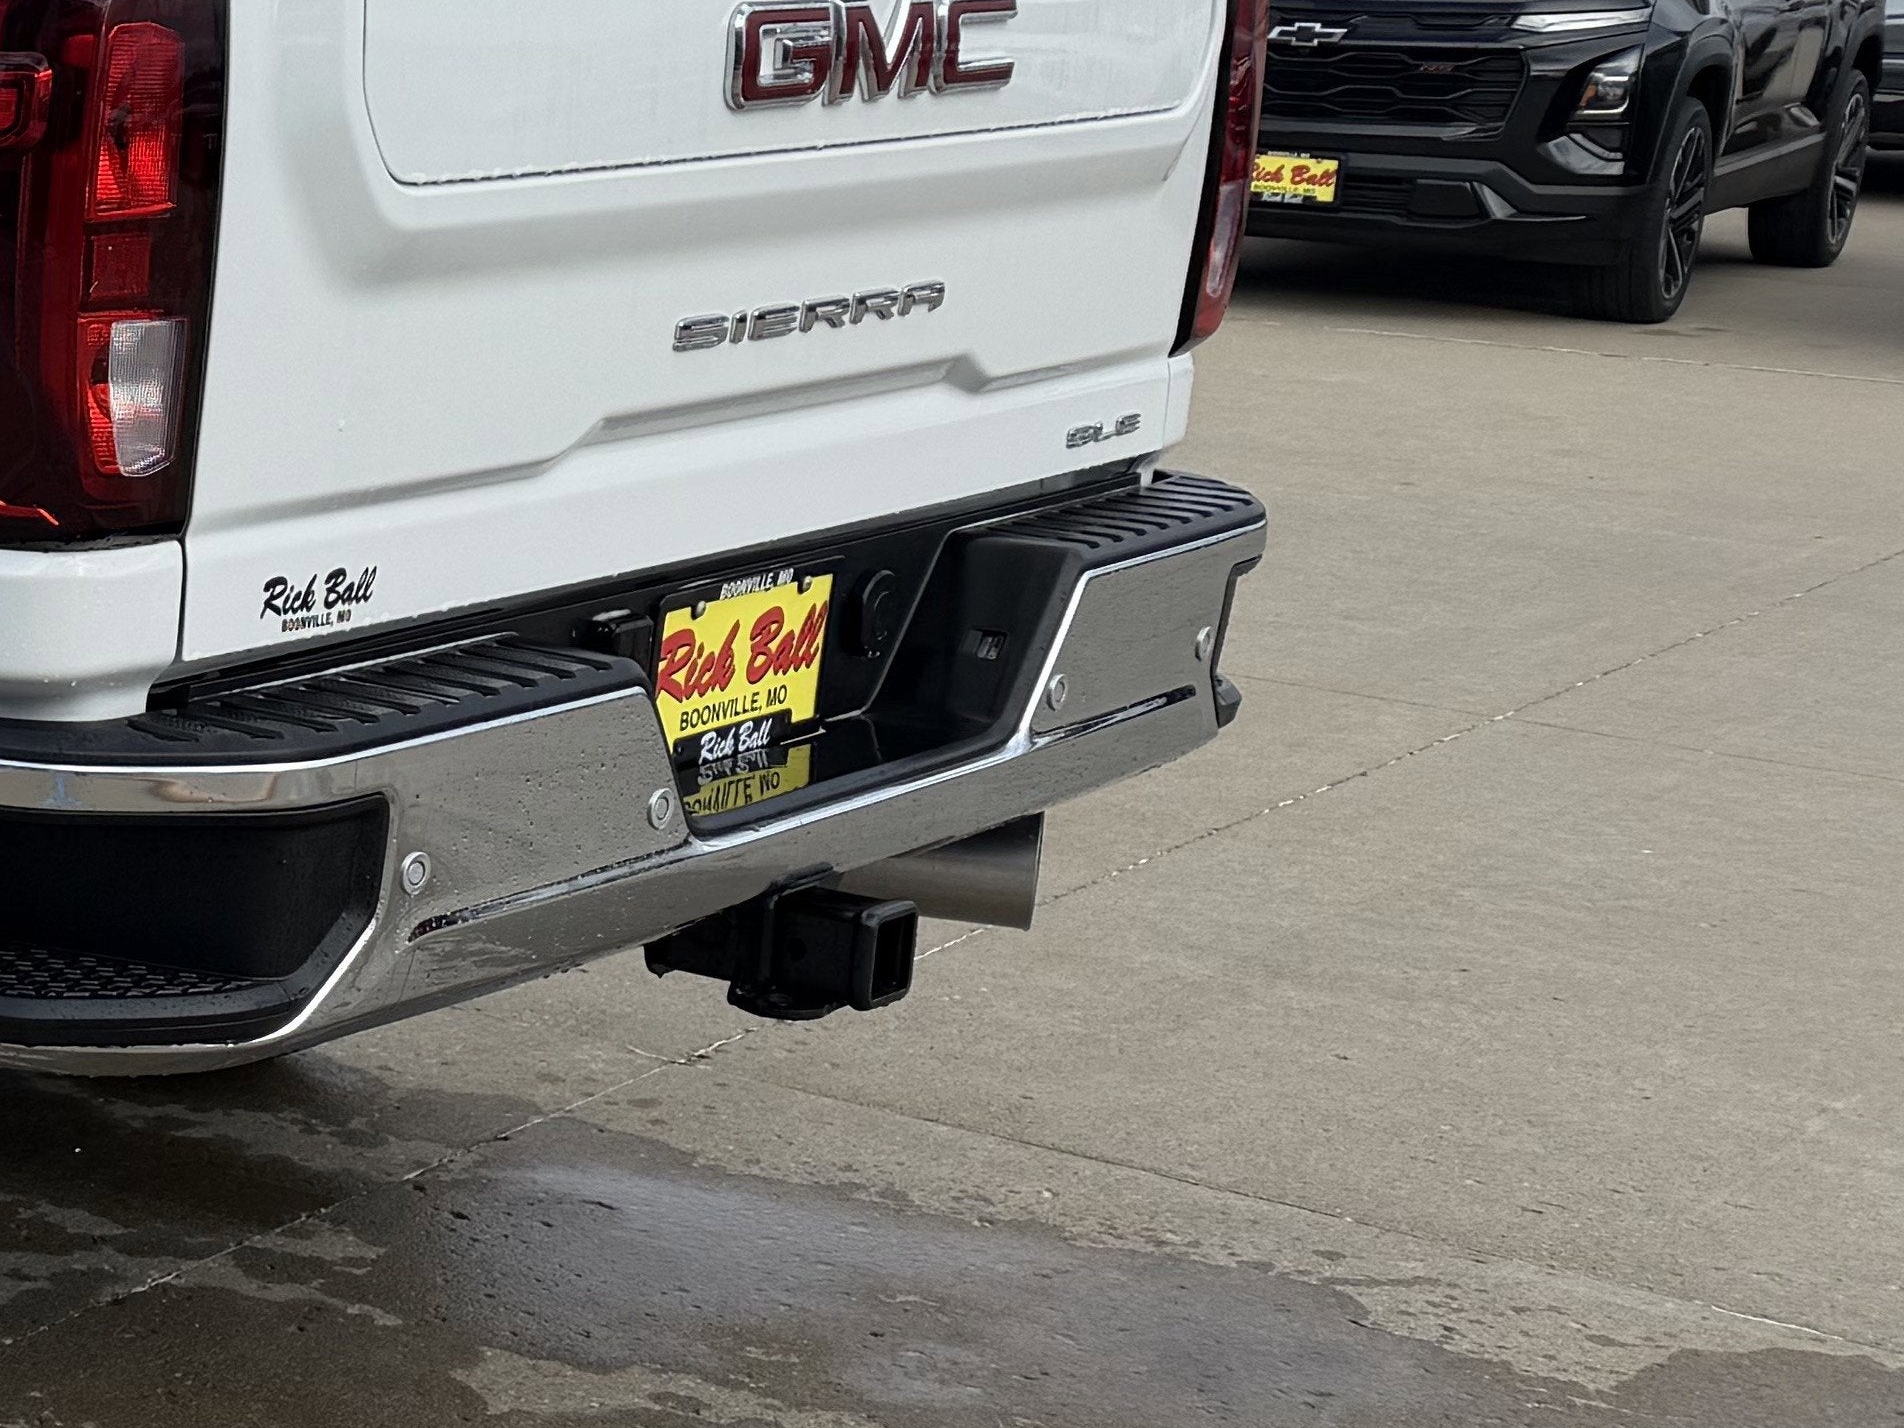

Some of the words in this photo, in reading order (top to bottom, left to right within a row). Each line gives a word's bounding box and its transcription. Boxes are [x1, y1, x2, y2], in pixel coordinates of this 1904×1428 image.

[1290, 164, 1337, 187] Ball
[671, 278, 947, 353] SIERRA
[1065, 411, 1143, 450] SLE
[259, 573, 318, 620] Rick
[323, 565, 378, 611] Ball
[777, 568, 795, 585] MO
[336, 608, 352, 623] MO
[655, 619, 741, 704] Rick
[745, 599, 829, 685] Ball
[679, 691, 763, 731] BOONVILLE,
[765, 684, 788, 707] MO
[698, 728, 735, 765] Rick
[738, 717, 773, 750] Ball
